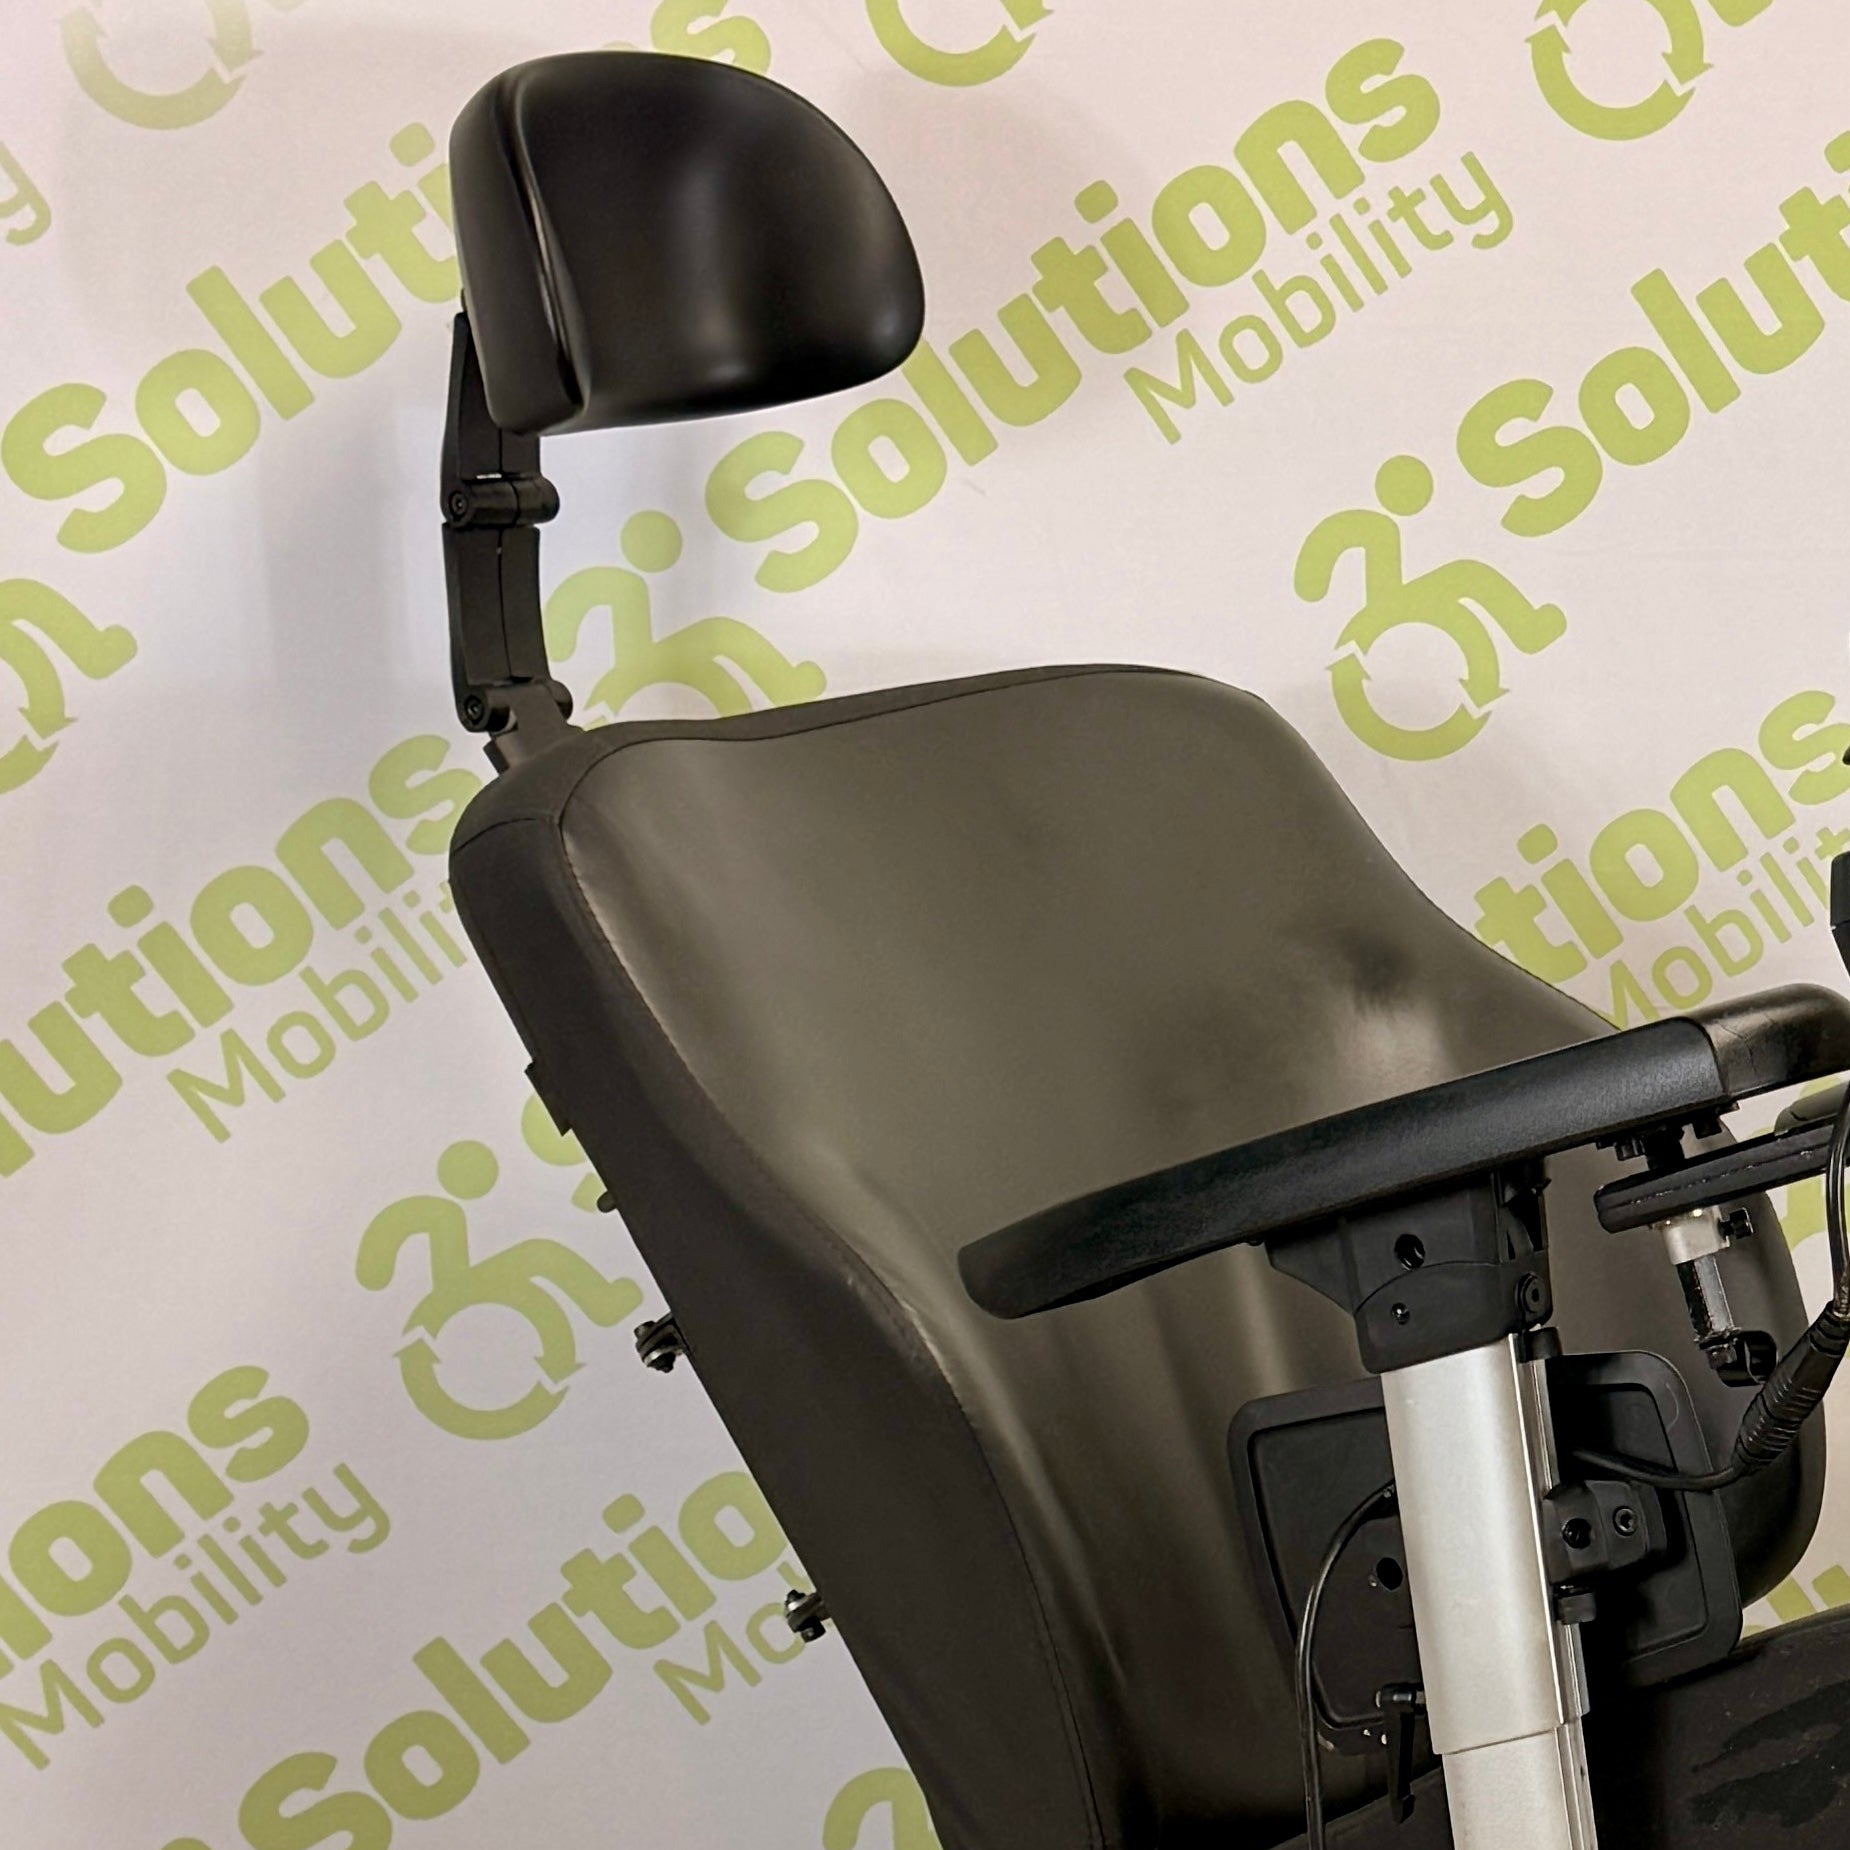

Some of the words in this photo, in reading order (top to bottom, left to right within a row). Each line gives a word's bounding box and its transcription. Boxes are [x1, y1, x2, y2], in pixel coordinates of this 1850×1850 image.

[706, 37, 1441, 593] Solutions
[1124, 151, 1515, 445] Mobility
[0, 733, 483, 1179] utions
[0, 1462, 391, 1771] Mobility
